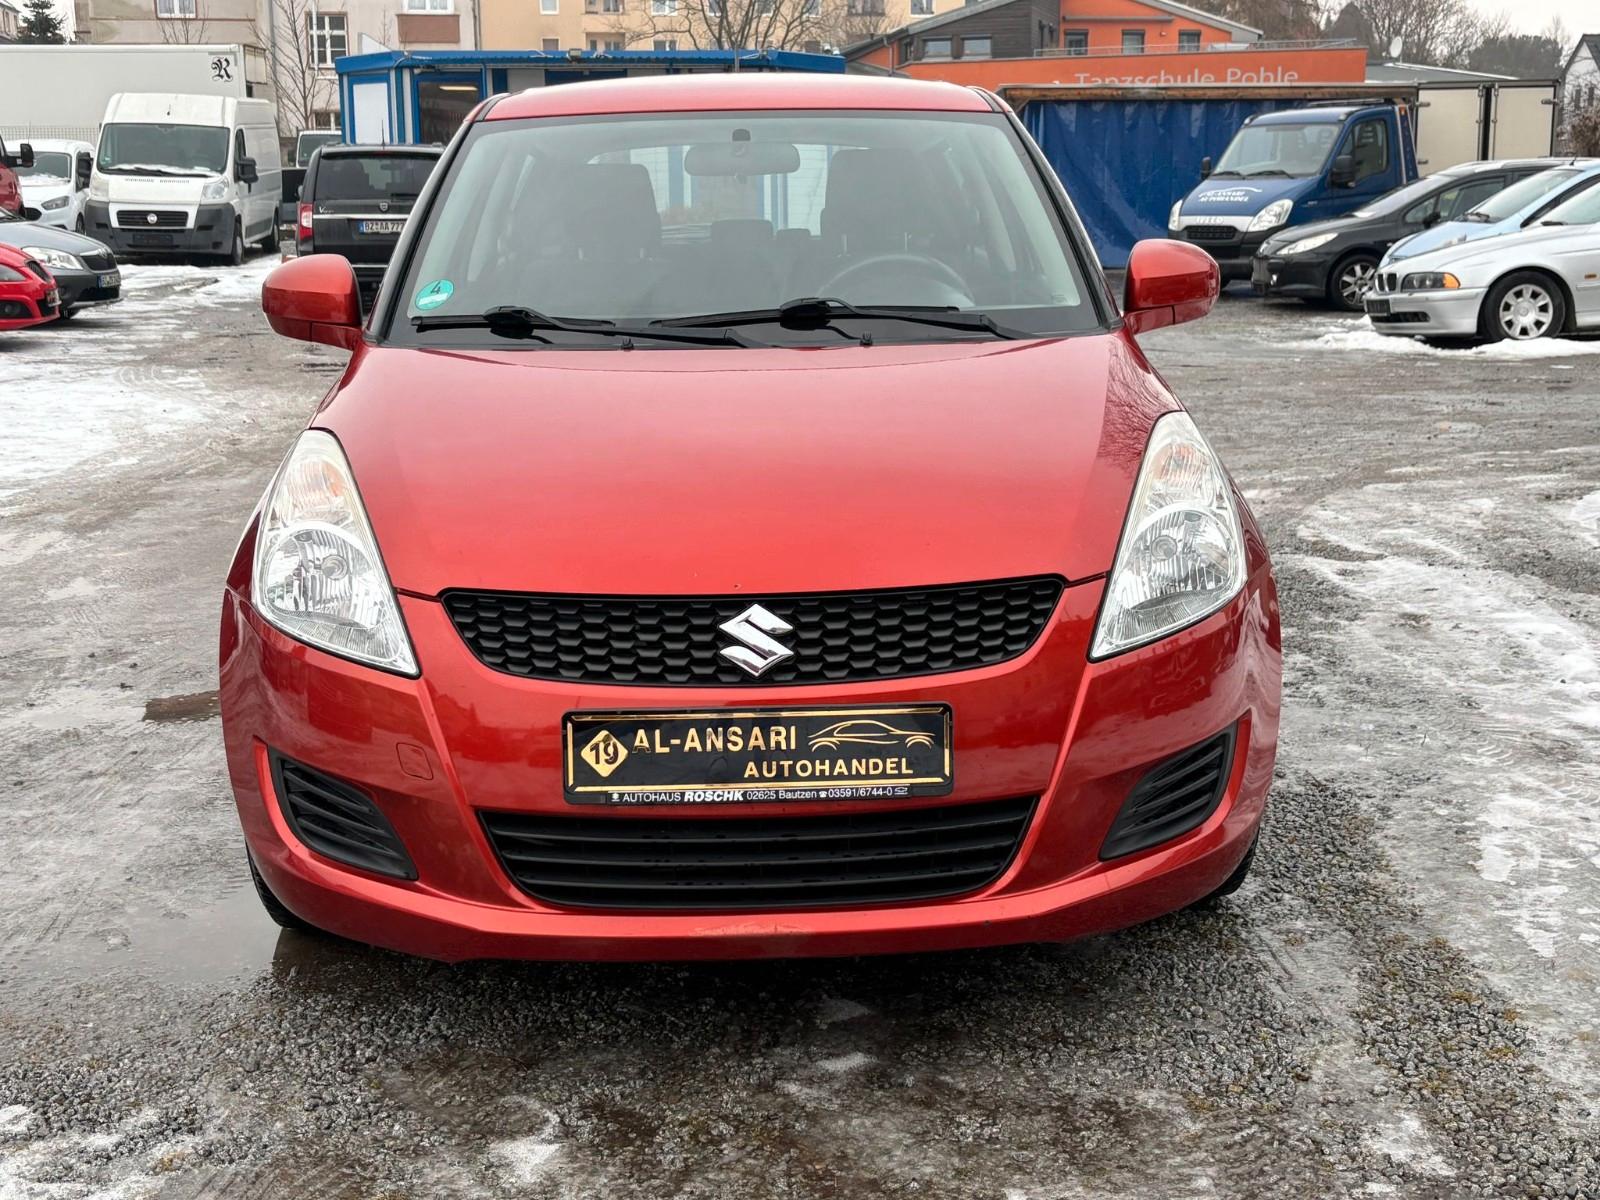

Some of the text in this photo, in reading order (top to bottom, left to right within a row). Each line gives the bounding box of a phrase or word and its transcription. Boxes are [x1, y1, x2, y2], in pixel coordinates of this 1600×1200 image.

[1227, 65, 1299, 83] Pohle
[430, 280, 442, 294] 4
[632, 726, 796, 753] AL-ANSARI
[589, 740, 619, 765] 19
[743, 758, 913, 778] AUTOHANDEL
[622, 792, 682, 803] AUTOHAUS
[746, 789, 776, 801] 02625
[778, 787, 818, 799] Bautzen
[828, 786, 893, 799] 03591/6744-0
